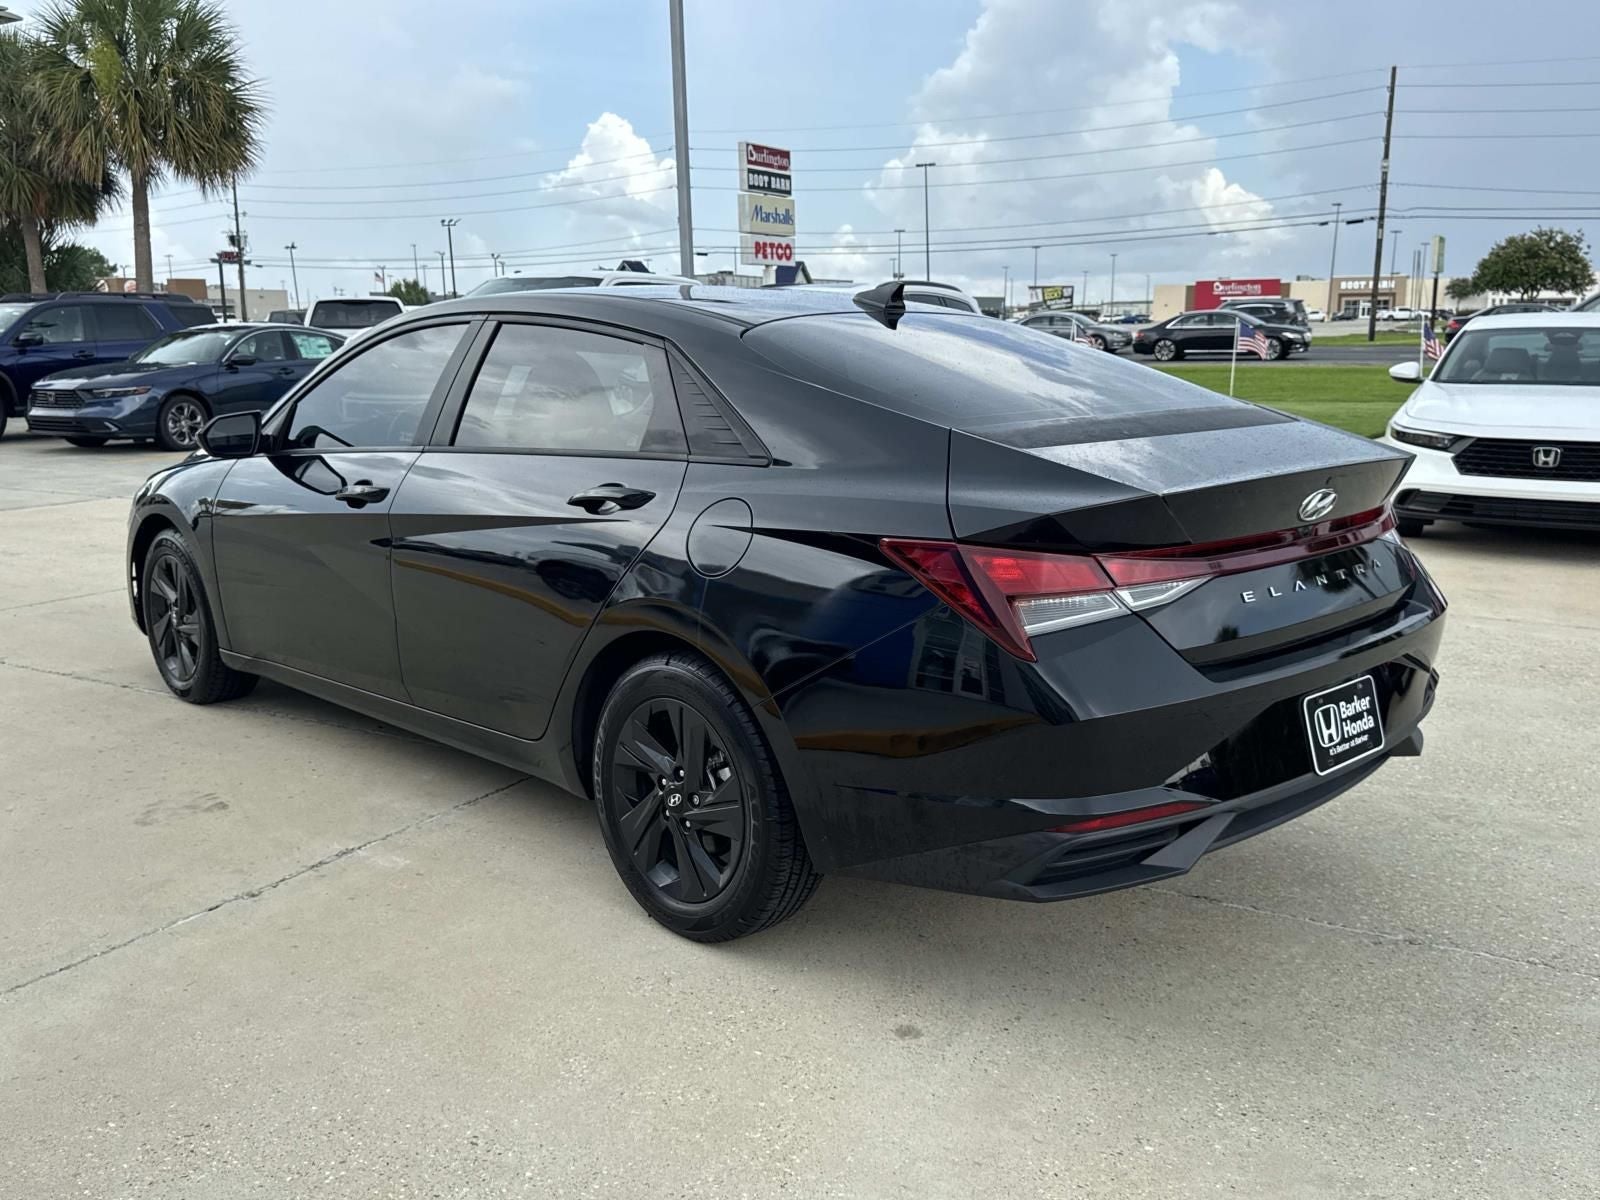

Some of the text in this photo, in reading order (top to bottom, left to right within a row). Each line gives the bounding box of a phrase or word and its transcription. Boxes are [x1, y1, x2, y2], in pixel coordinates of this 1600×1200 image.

[748, 145, 789, 169] Burlington
[748, 173, 790, 191] BOOT BARN
[751, 205, 793, 225] Marshalls
[754, 241, 792, 261] PETCO
[1340, 280, 1366, 289] BOOT
[1241, 559, 1381, 603] ELANTRA
[1339, 695, 1371, 719] Barker
[1342, 712, 1375, 738] Honda
